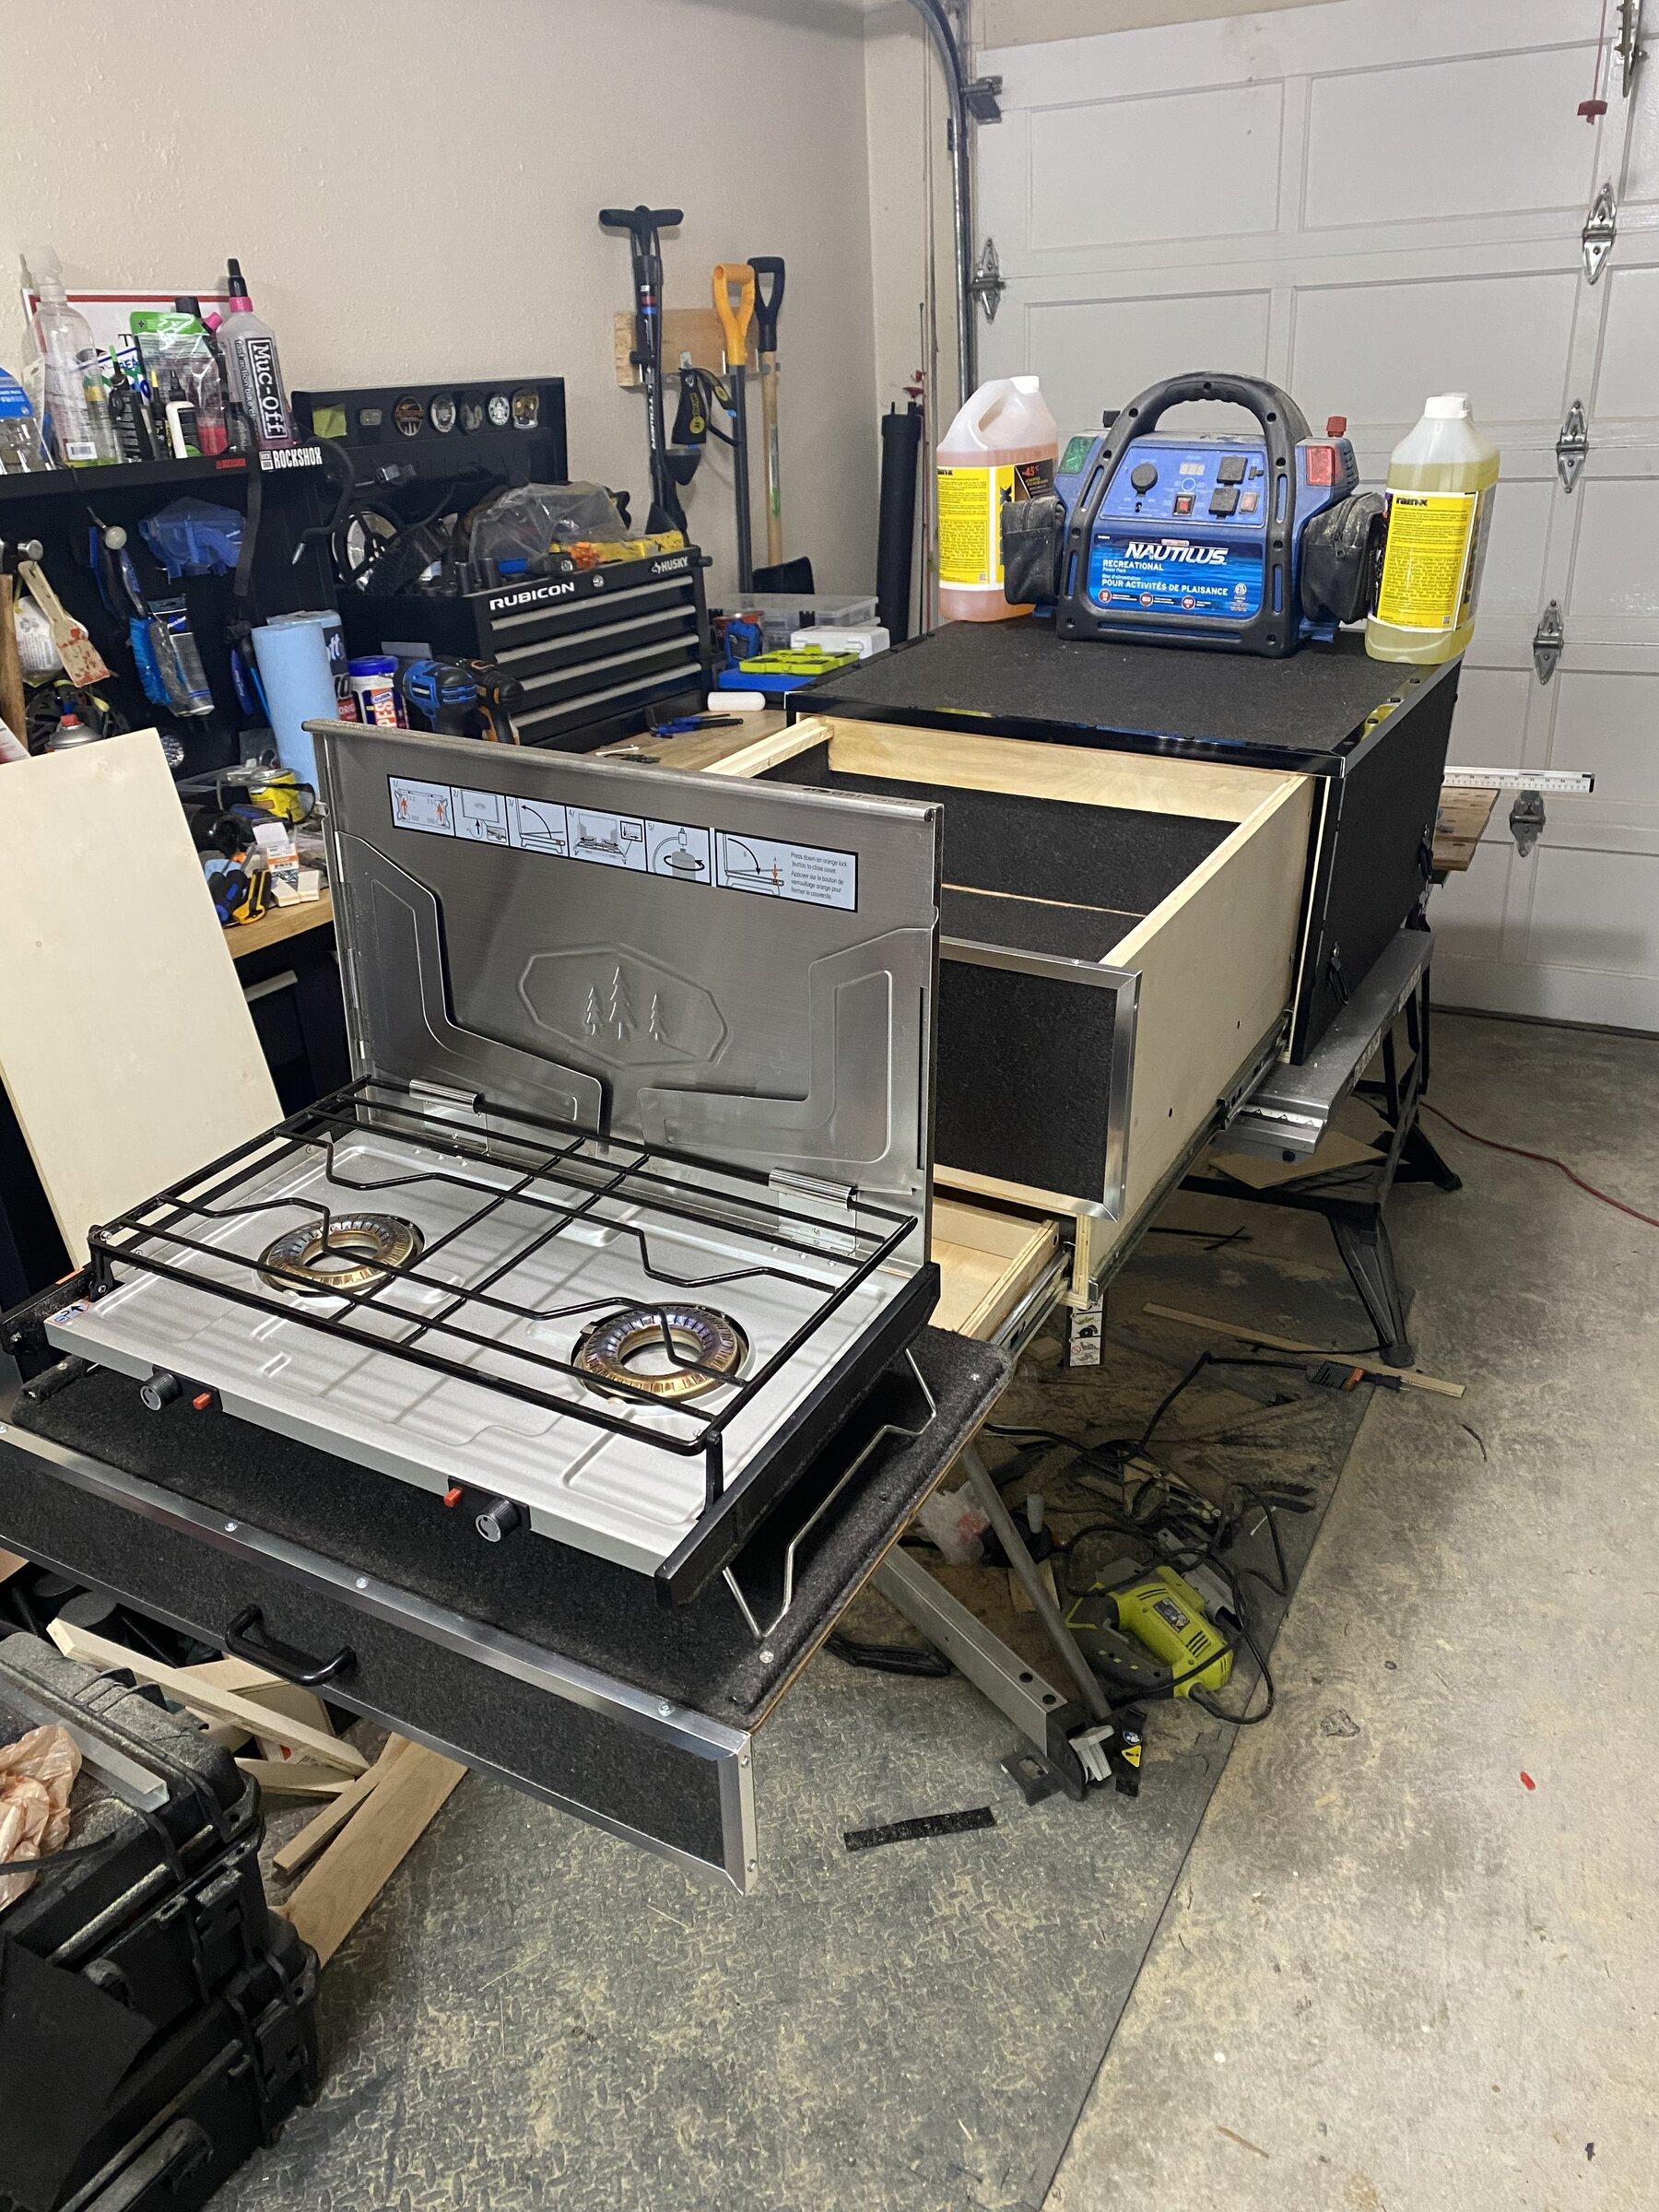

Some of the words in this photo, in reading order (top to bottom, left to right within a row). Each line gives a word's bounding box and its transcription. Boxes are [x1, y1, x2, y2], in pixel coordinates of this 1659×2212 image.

[253, 344, 287, 437] Muc-Off
[272, 447, 323, 470] ROCKSHOX
[1124, 542, 1229, 565] NAUTILUS
[661, 556, 688, 572] HUSKY
[1102, 559, 1164, 571] RECREATIONAL
[489, 582, 575, 610] RUBICON
[1101, 579, 1124, 587] POUR
[1125, 580, 1167, 591] ACTIVITÉS
[1182, 585, 1229, 596] PLAISANCE
[790, 852, 803, 860] Press
[823, 858, 838, 866] orange
[838, 859, 848, 867] lock
[791, 870, 808, 879] Appuyer
[822, 876, 838, 884] bouton
